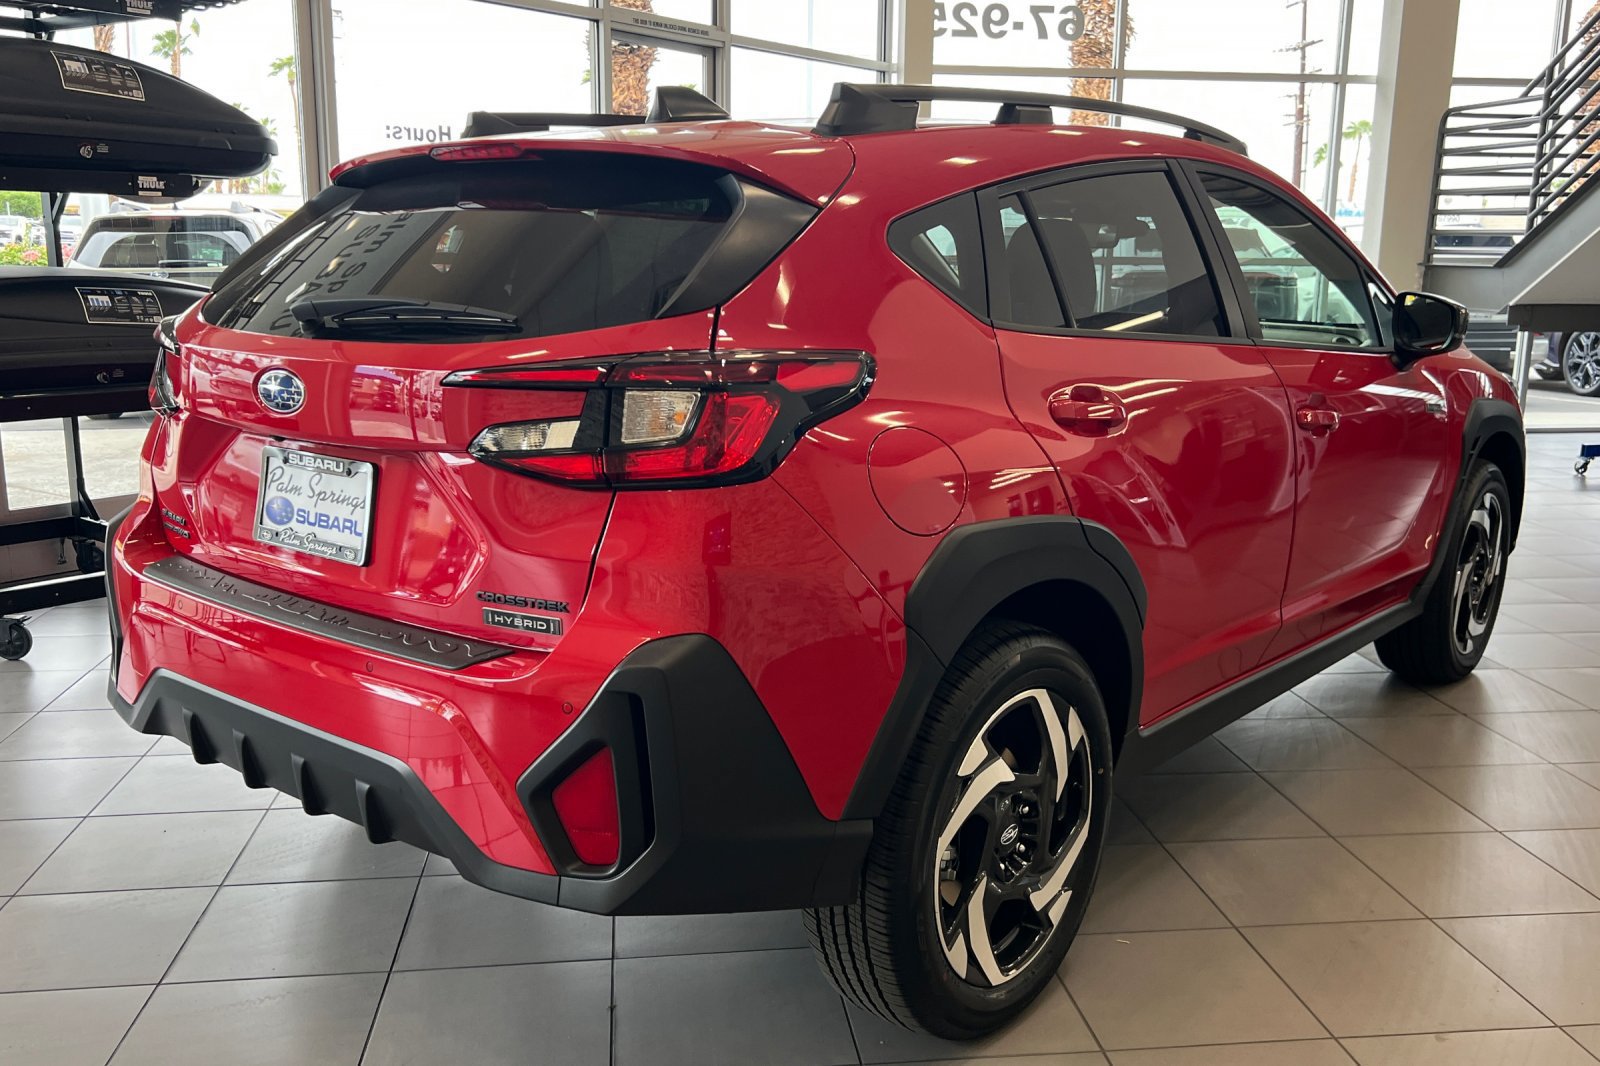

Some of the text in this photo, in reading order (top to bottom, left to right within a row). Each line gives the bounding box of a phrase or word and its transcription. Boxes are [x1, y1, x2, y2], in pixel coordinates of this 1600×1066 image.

[127, 0, 153, 9] THULE
[137, 180, 166, 189] THULE
[269, 223, 381, 331] SUBAU
[288, 453, 344, 472] SUBARU
[267, 465, 366, 515] Palm Springs
[279, 528, 337, 555] Palm Springs
[476, 590, 570, 613] CROSSTREK
[494, 614, 547, 629] HYBRID
